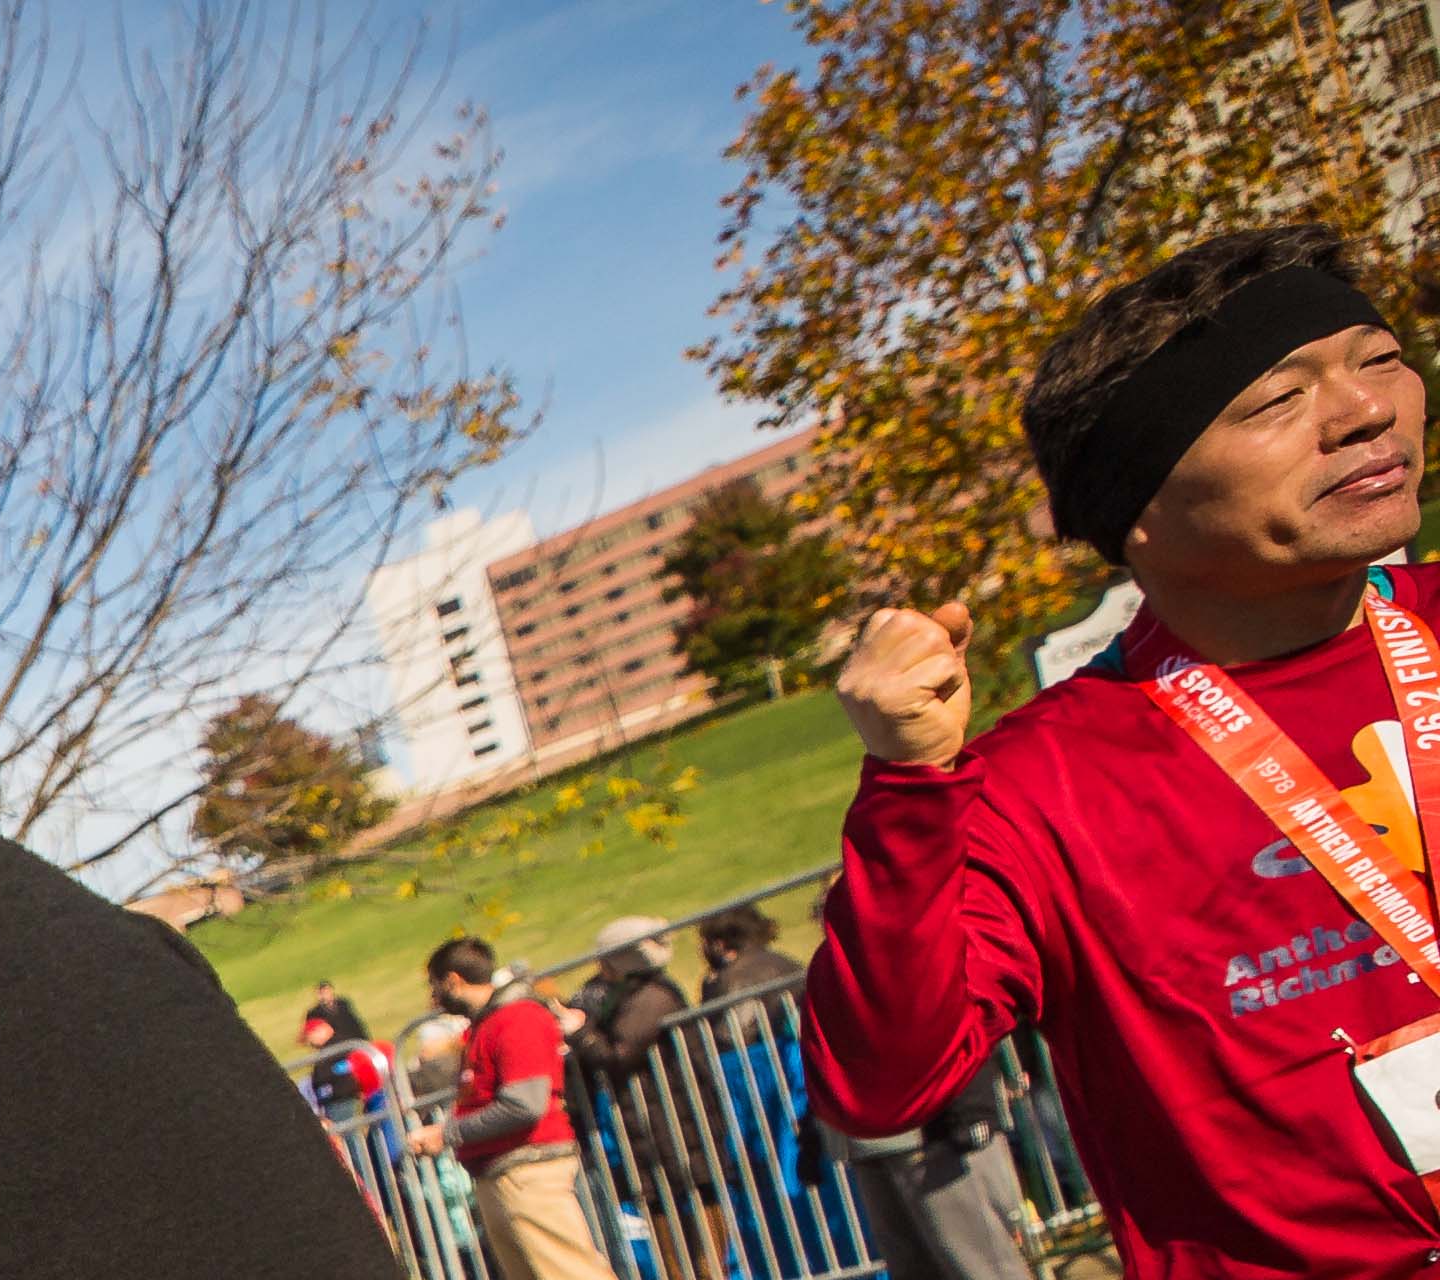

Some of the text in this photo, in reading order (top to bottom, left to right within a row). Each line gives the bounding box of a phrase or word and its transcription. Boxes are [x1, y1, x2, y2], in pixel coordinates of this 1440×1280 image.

[1172, 694, 1228, 743] BACKERS
[1180, 670, 1253, 733] SPORTS
[1256, 757, 1435, 942] 1978 ANTHEM RICHMOND
[1224, 921, 1373, 987] Anthe
[1231, 945, 1401, 1018] Richmo
